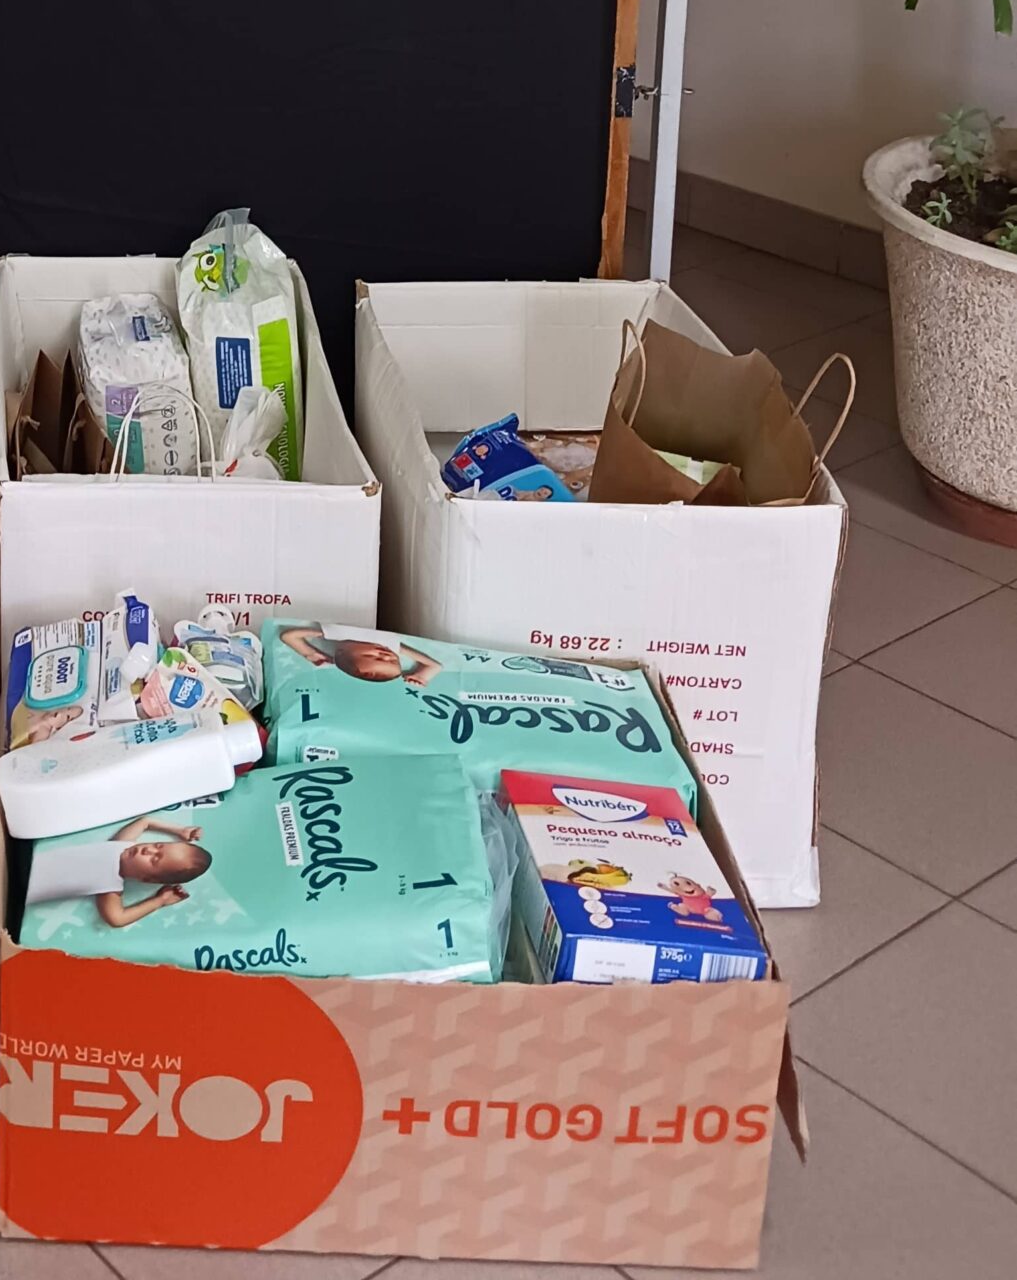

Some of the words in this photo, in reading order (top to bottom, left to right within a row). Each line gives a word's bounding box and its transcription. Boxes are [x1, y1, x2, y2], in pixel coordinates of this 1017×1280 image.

[206, 592, 241, 605] TRIFI
[245, 593, 292, 606] TROFA
[529, 630, 554, 648] kg
[558, 634, 611, 651] 22.68
[646, 639, 710, 655] WEIGHT
[714, 643, 747, 657] NET
[55, 656, 71, 685] DODOT
[665, 675, 743, 690] CARTON#
[466, 693, 516, 703] PREMIUM
[521, 694, 567, 704] FRALDAS
[421, 692, 663, 754] Rascals
[706, 708, 739, 722] LOT
[564, 795, 639, 812] Nutribén
[273, 765, 379, 891] Rascals
[668, 822, 682, 831] 12
[546, 824, 618, 838] Pequeno
[622, 831, 682, 847] almoço
[286, 831, 300, 861] PREMIUM
[436, 918, 454, 949] 1
[193, 927, 296, 971] Rascals
[659, 949, 683, 962] 375g
[75, 1047, 145, 1068] PAPER
[151, 1055, 182, 1070] MY
[444, 1098, 604, 1143] GOLD
[614, 1102, 770, 1147] SOFT
